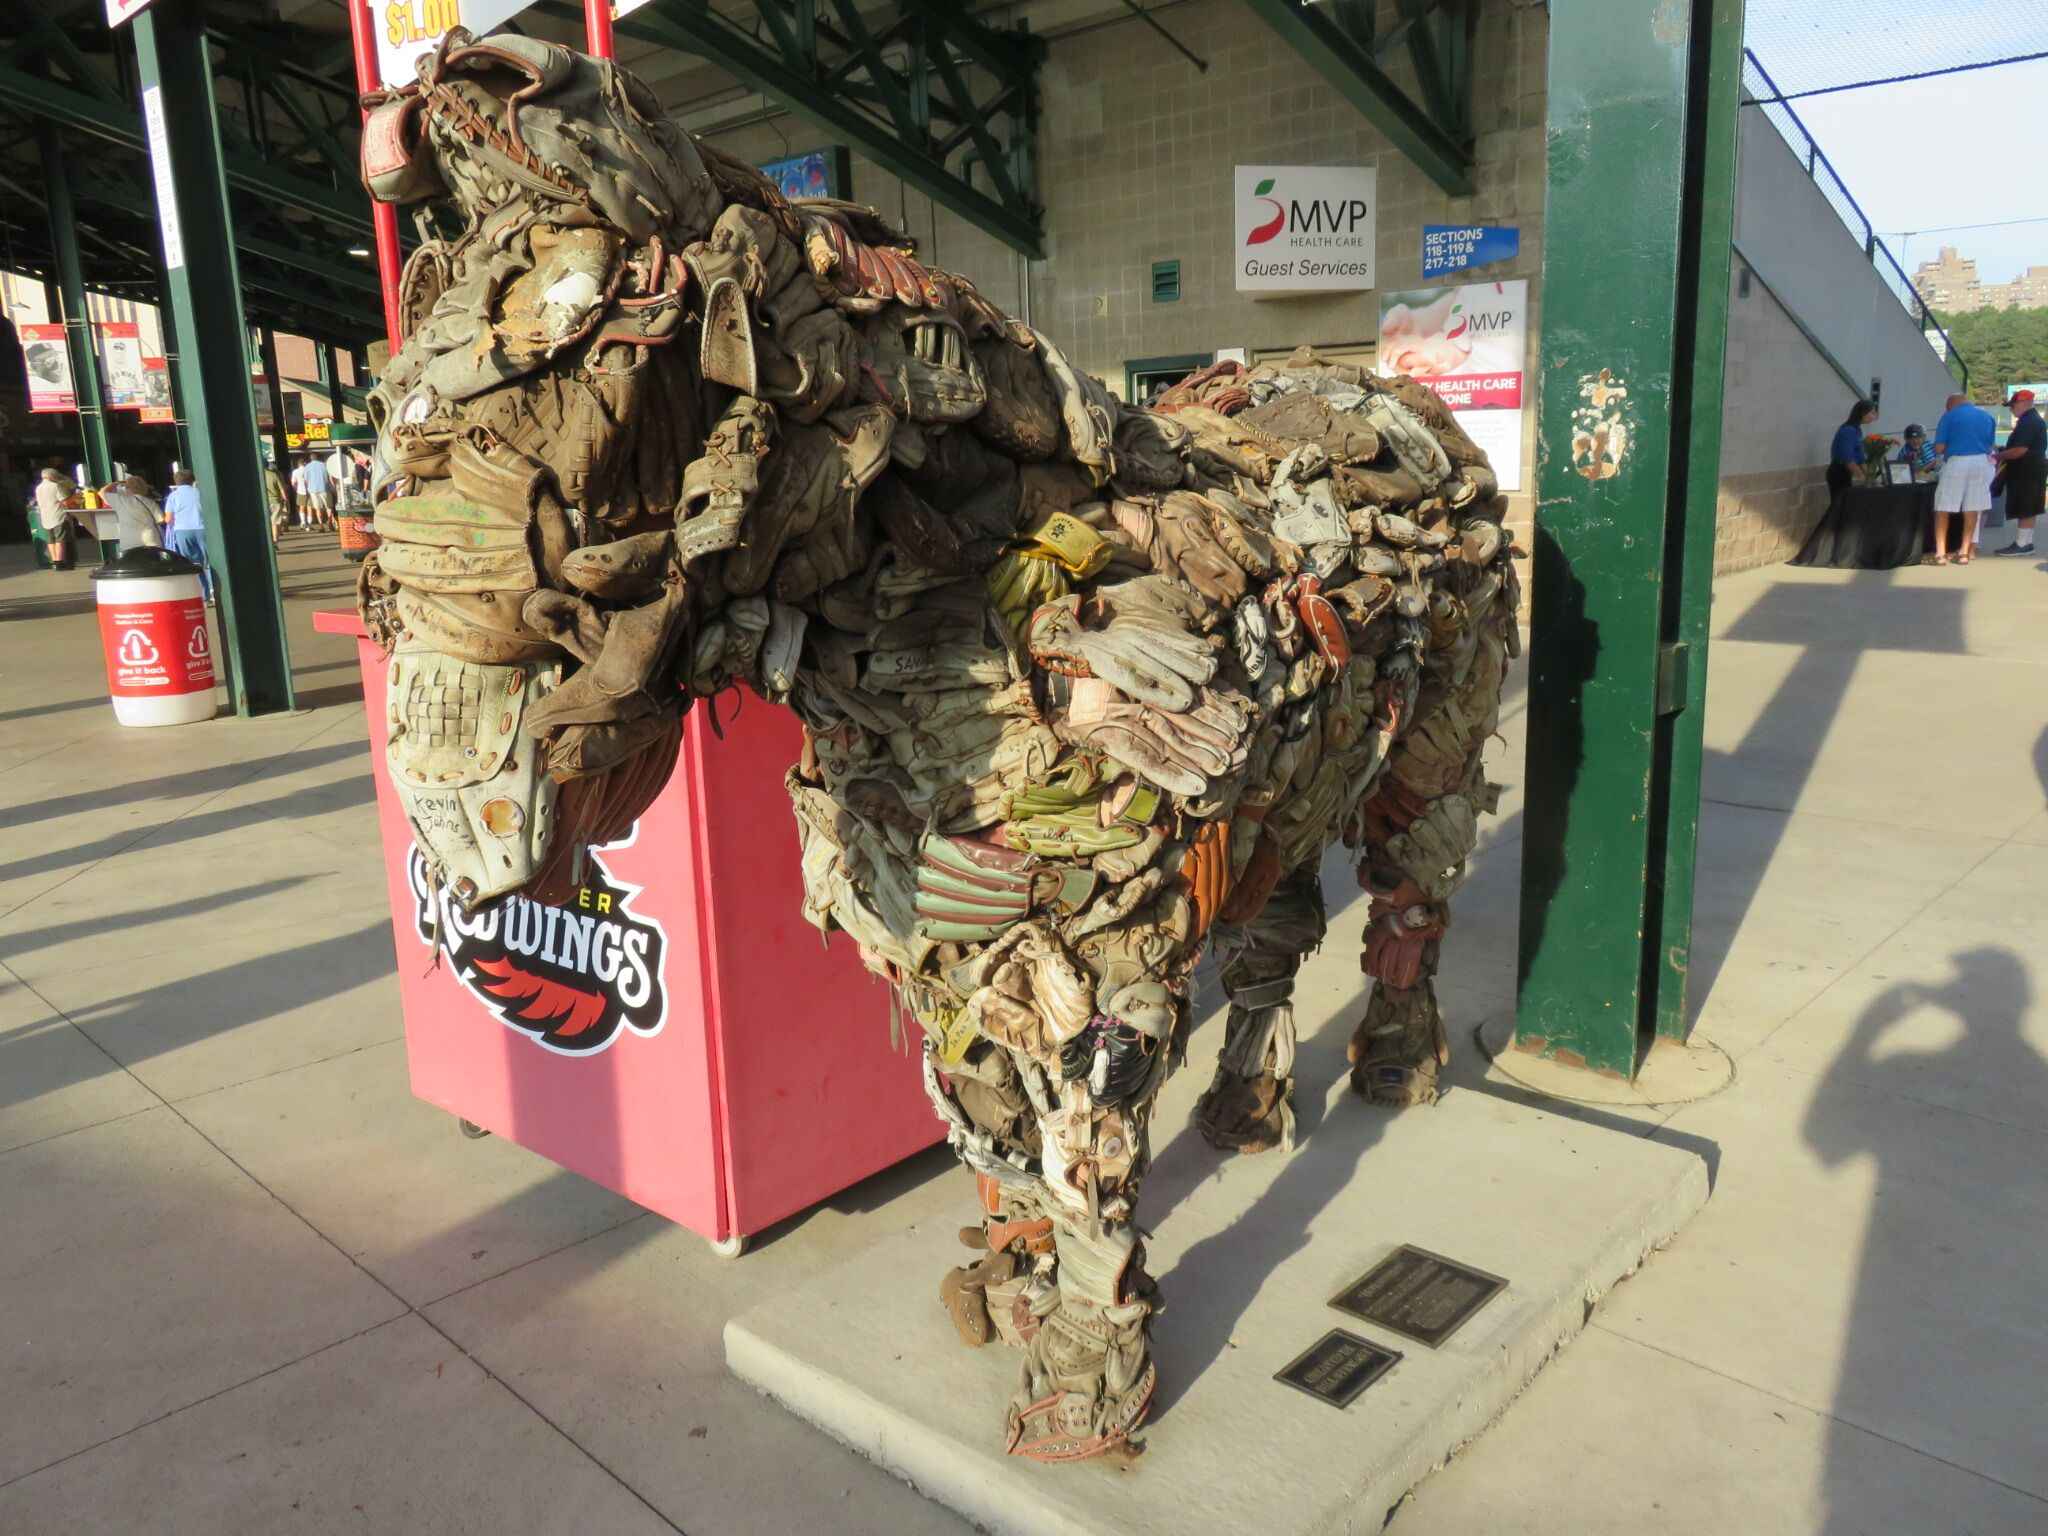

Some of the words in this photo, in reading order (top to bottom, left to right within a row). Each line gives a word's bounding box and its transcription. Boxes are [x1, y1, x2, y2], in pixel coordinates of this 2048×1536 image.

[386, 0, 460, 48] $1.00
[1290, 200, 1367, 233] MVP
[1290, 237, 1332, 247] HEALTH
[1336, 237, 1363, 247] CARE
[1426, 228, 1483, 245] SECTIONS
[1245, 259, 1294, 276] Guest
[1298, 259, 1367, 276] Services
[1425, 255, 1467, 270] 217-218
[1469, 311, 1512, 332] MVP
[1435, 379, 1480, 392] HEALTH
[1483, 378, 1517, 390] CARE
[1439, 393, 1472, 404] YONE
[304, 423, 329, 439] Red
[119, 667, 133, 677] give
[134, 667, 142, 675] it
[413, 794, 457, 816] Kevin
[579, 888, 611, 914] ER
[504, 895, 651, 1008] WINGS
